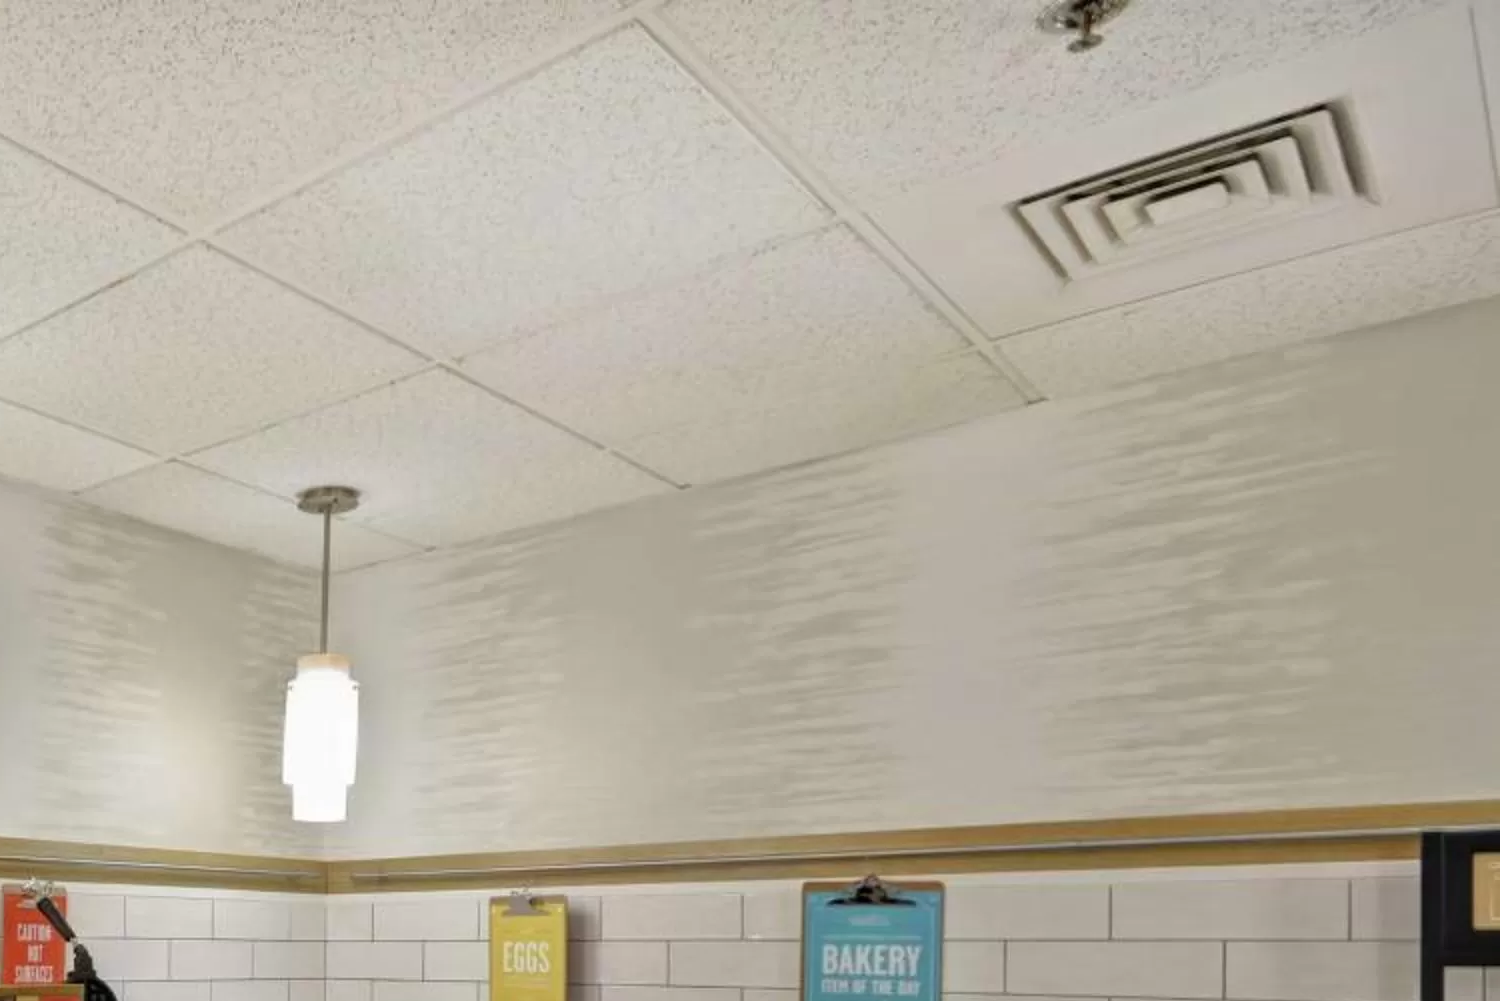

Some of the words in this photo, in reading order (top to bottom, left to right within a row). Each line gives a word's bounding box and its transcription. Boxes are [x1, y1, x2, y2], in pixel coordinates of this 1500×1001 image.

[17, 923, 52, 942] CAUTION
[502, 941, 550, 973] EGGS
[821, 943, 922, 977] BAKERY
